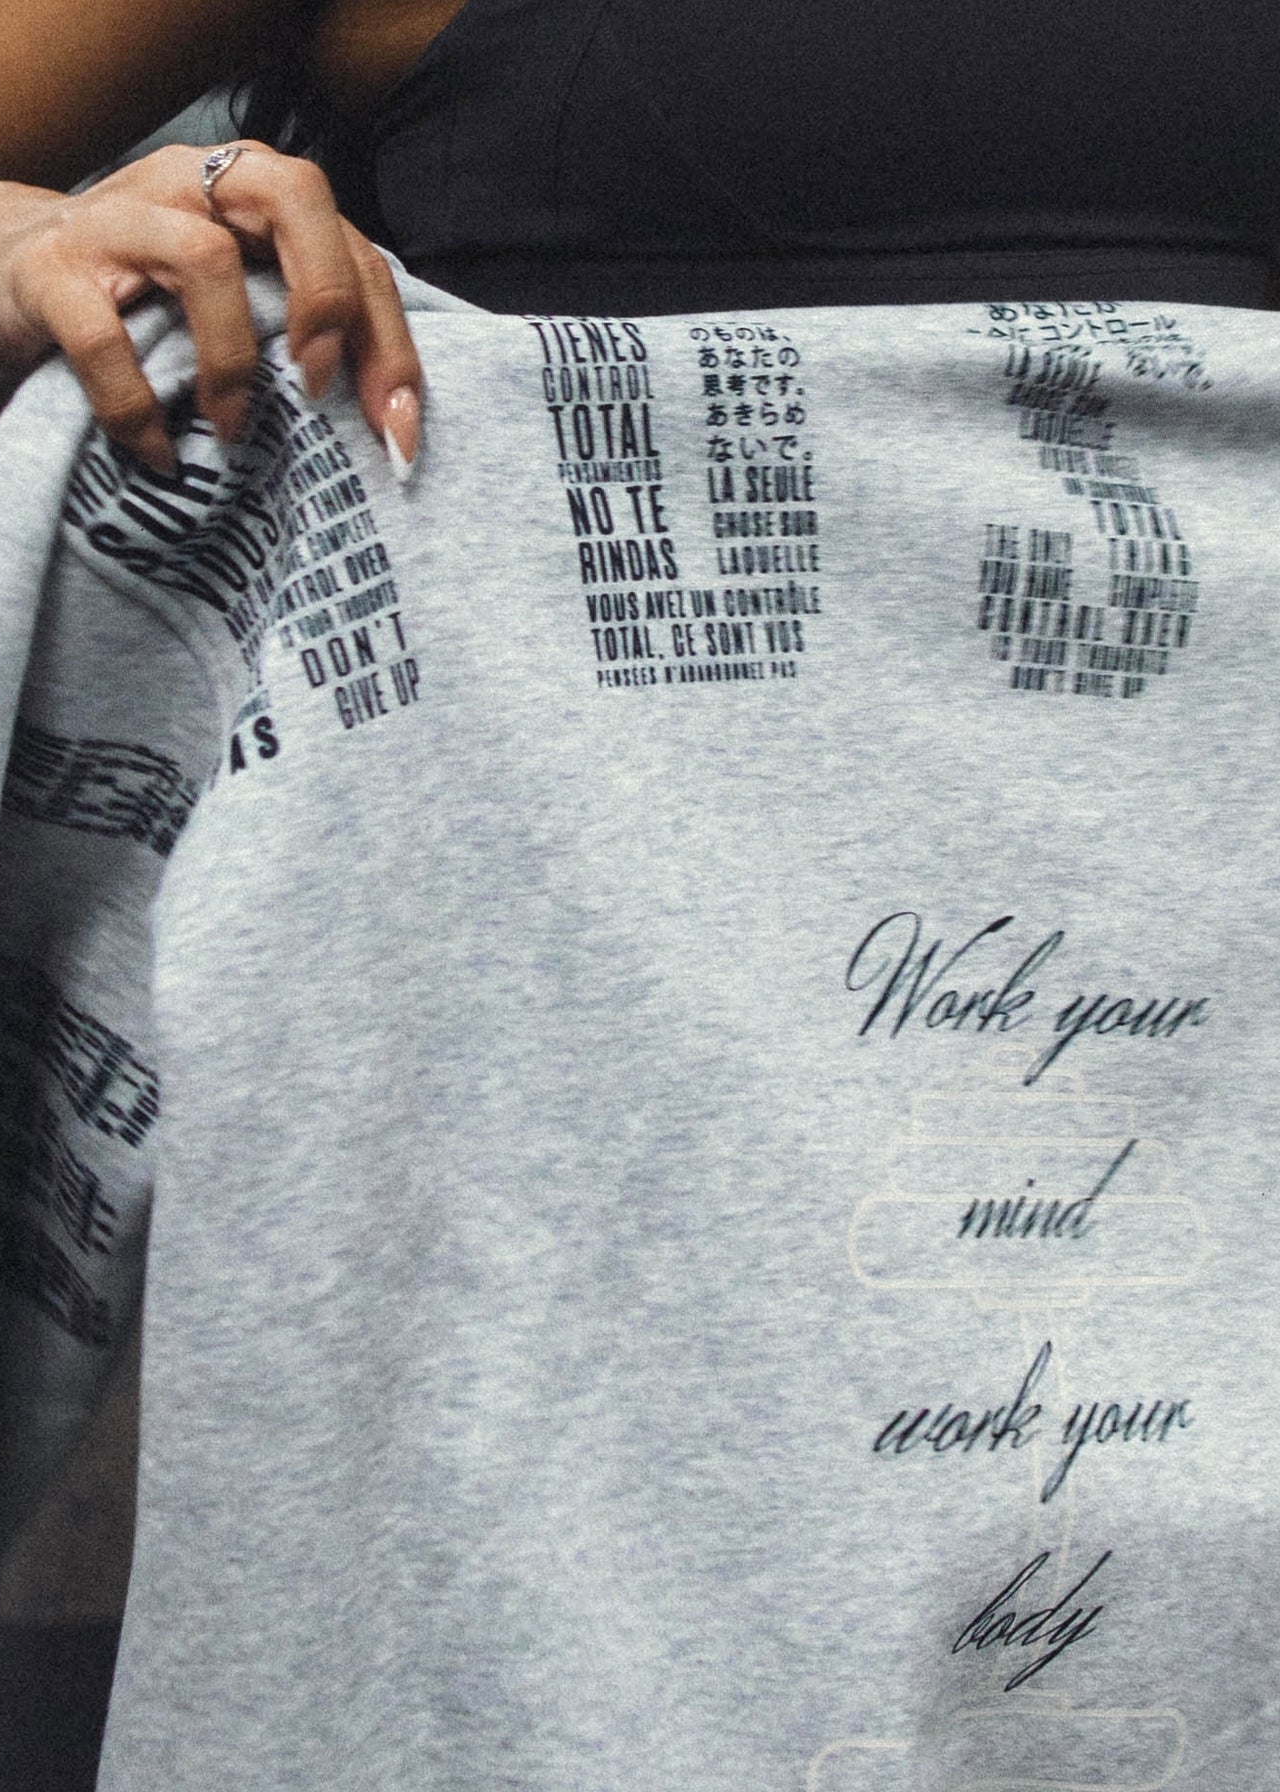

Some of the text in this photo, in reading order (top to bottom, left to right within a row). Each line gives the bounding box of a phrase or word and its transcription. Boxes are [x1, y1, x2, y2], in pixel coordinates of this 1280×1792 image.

[530, 321, 648, 364] TIENES
[698, 345, 801, 369] あなたの
[542, 364, 655, 403] CONTROL
[546, 403, 661, 461] TOTAL
[706, 435, 814, 463] ないで。
[707, 465, 816, 504] LA SEULE
[566, 484, 670, 538] NO TE
[578, 537, 679, 585] RINDAS
[586, 591, 640, 624] VOUS
[646, 589, 687, 621] AVEZ
[690, 588, 718, 619] UN
[300, 611, 407, 689] DON'T
[671, 622, 698, 658] CE
[704, 620, 756, 657] SONT
[763, 619, 806, 654] VOS
[333, 671, 390, 730] GIVE
[389, 658, 420, 707] UP
[845, 910, 1212, 1088] Work your
[956, 1138, 1138, 1240] mind
[873, 1339, 1196, 1505] work your
[952, 1549, 1113, 1692] body
